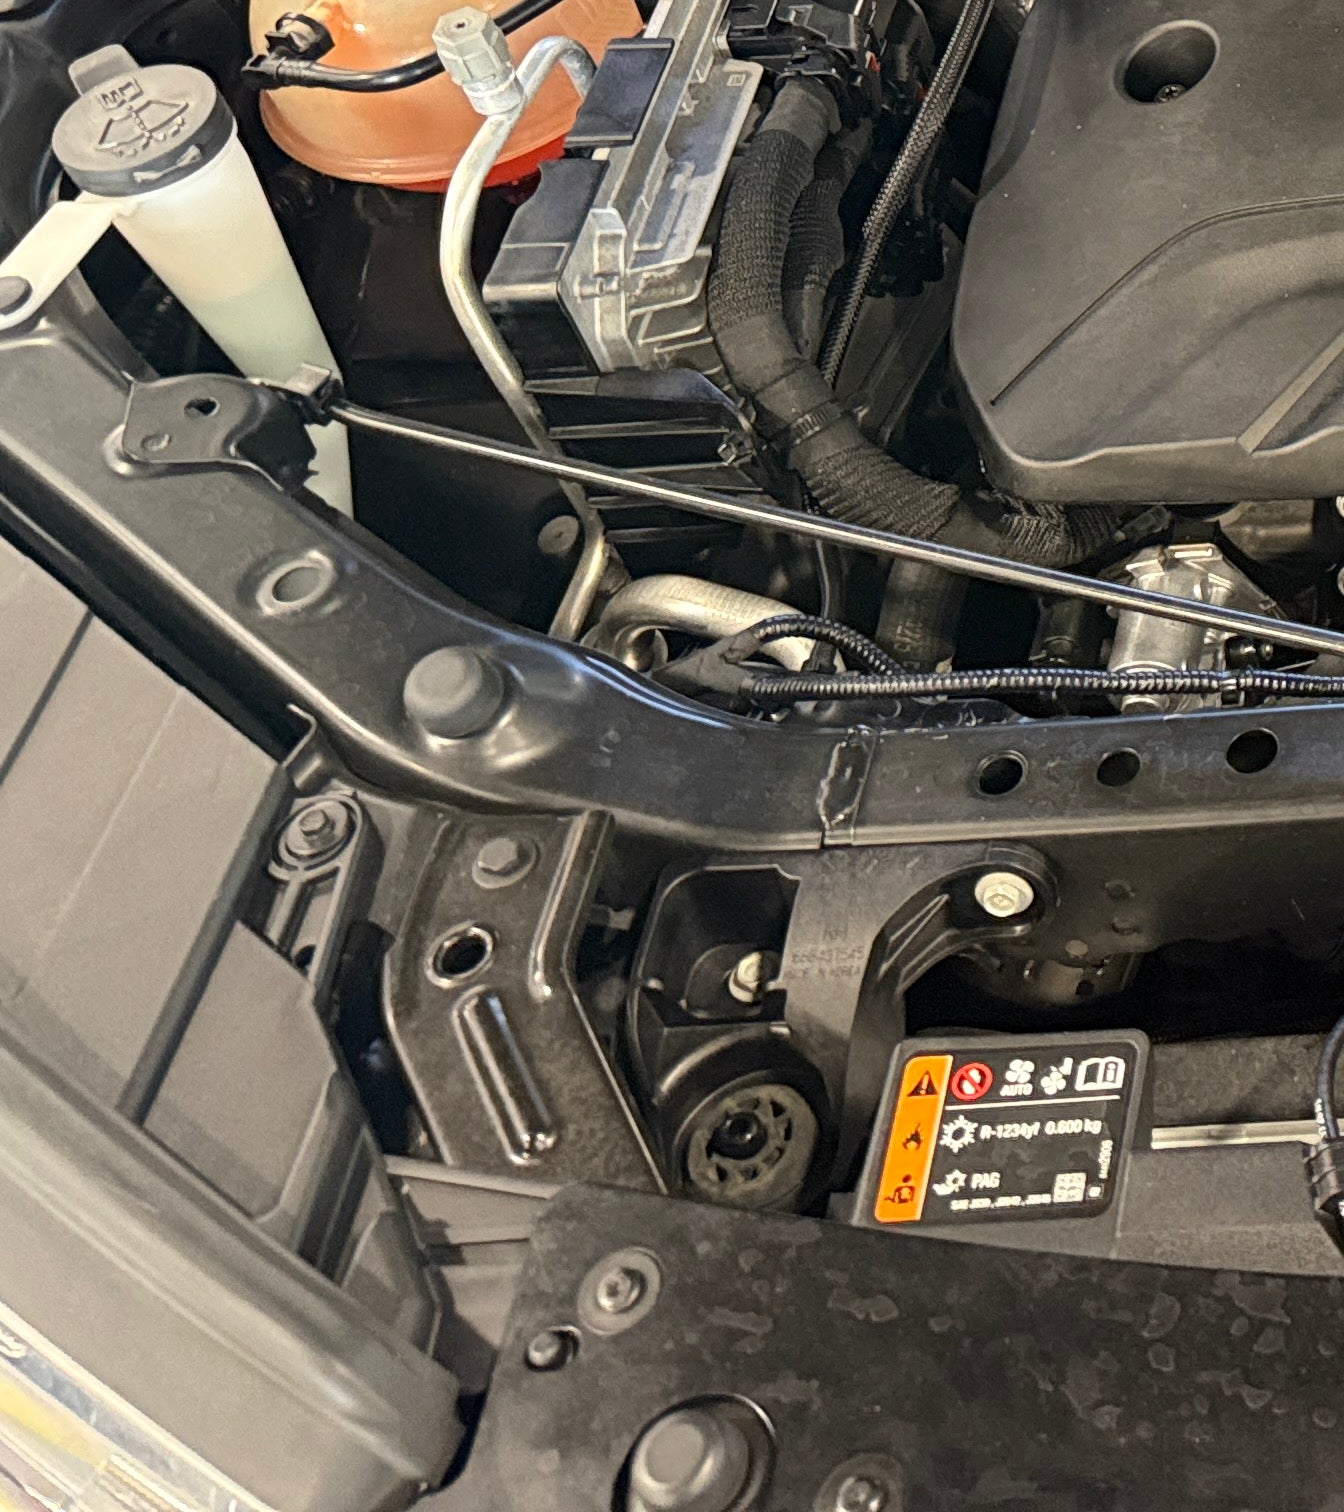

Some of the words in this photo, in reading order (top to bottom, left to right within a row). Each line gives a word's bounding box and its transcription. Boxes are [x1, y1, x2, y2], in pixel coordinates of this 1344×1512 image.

[1000, 1084, 1033, 1097] AUTO
[980, 1121, 1040, 1141] R-1234yf
[1044, 1119, 1083, 1136] 0.600
[1083, 1118, 1102, 1135] kg
[970, 1172, 1001, 1190] PAG
